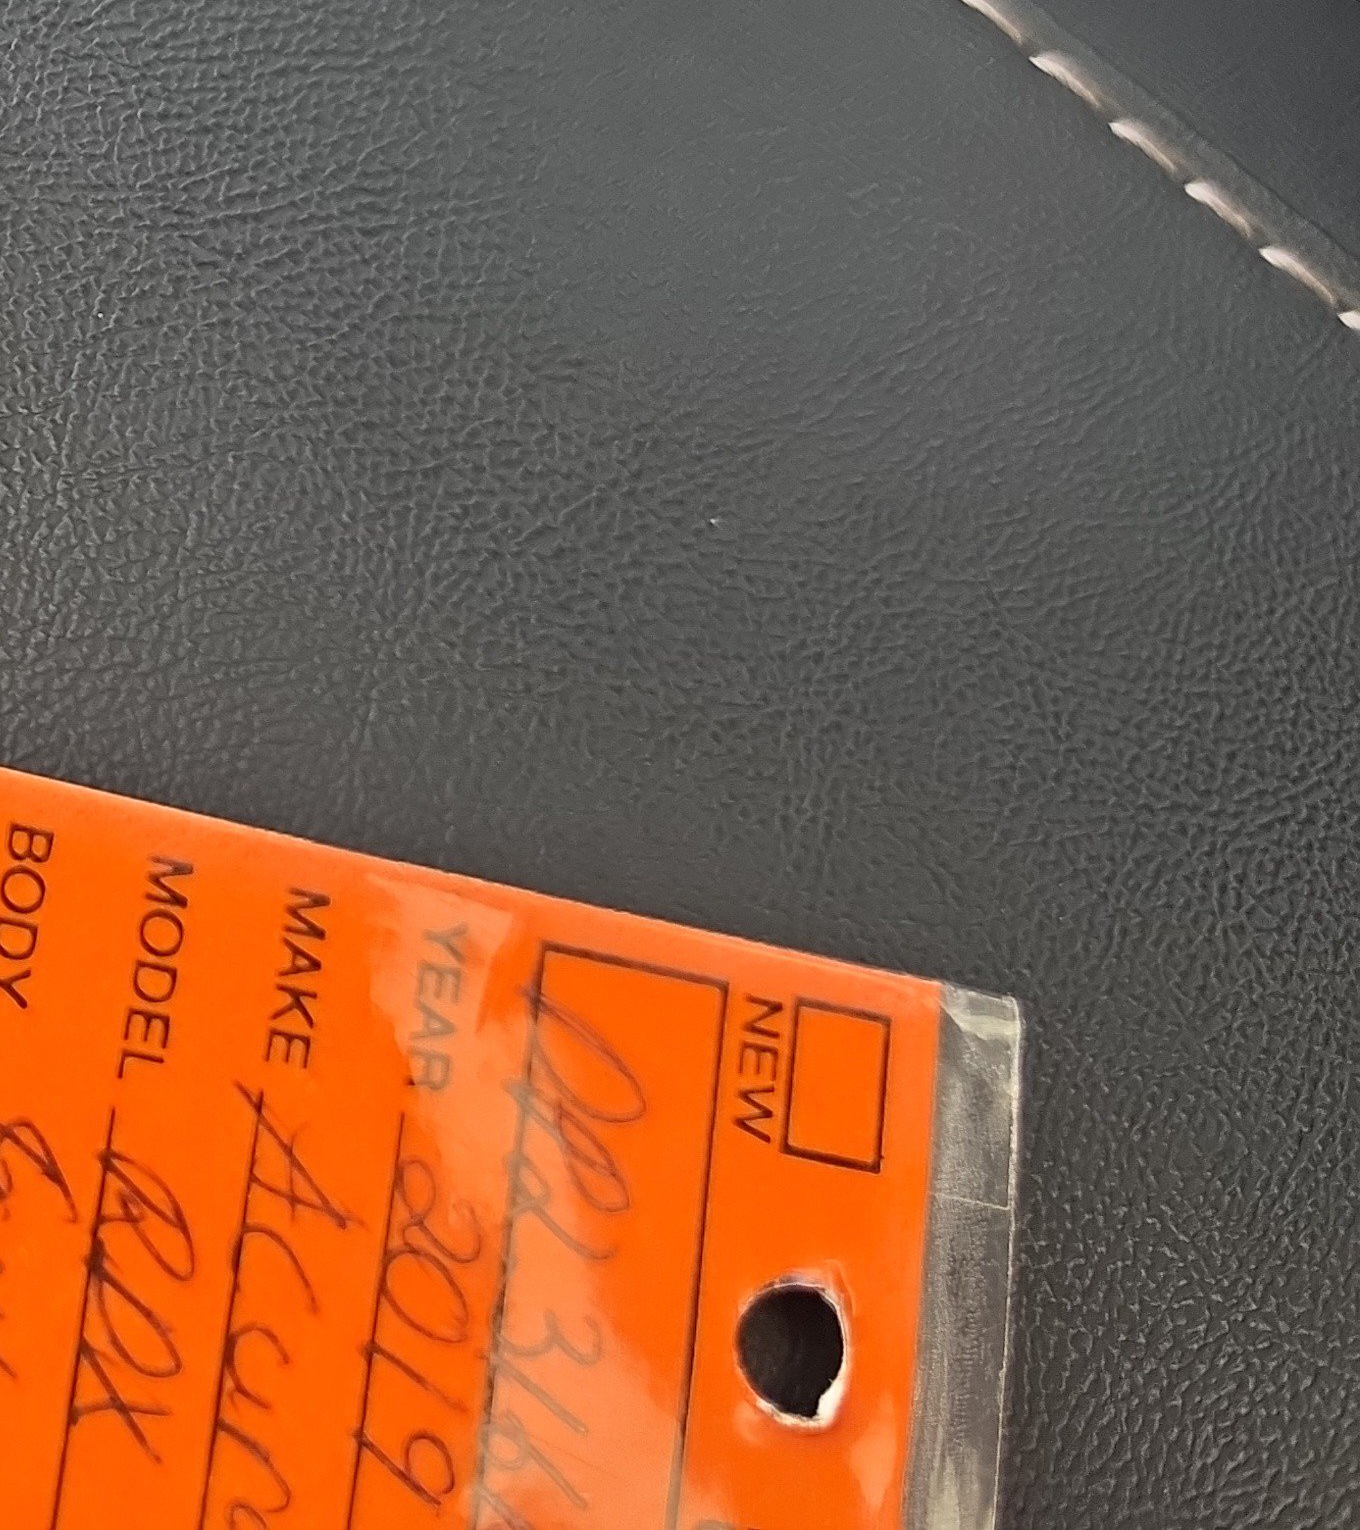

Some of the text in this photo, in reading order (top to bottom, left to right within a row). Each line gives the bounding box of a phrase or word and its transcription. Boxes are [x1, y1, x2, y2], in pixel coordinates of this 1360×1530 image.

[70, 856, 195, 1464] MODEL RDX
[264, 888, 332, 1070] MAKE
[733, 993, 784, 1144] NEW
[351, 922, 482, 1510] YEAR 2019
